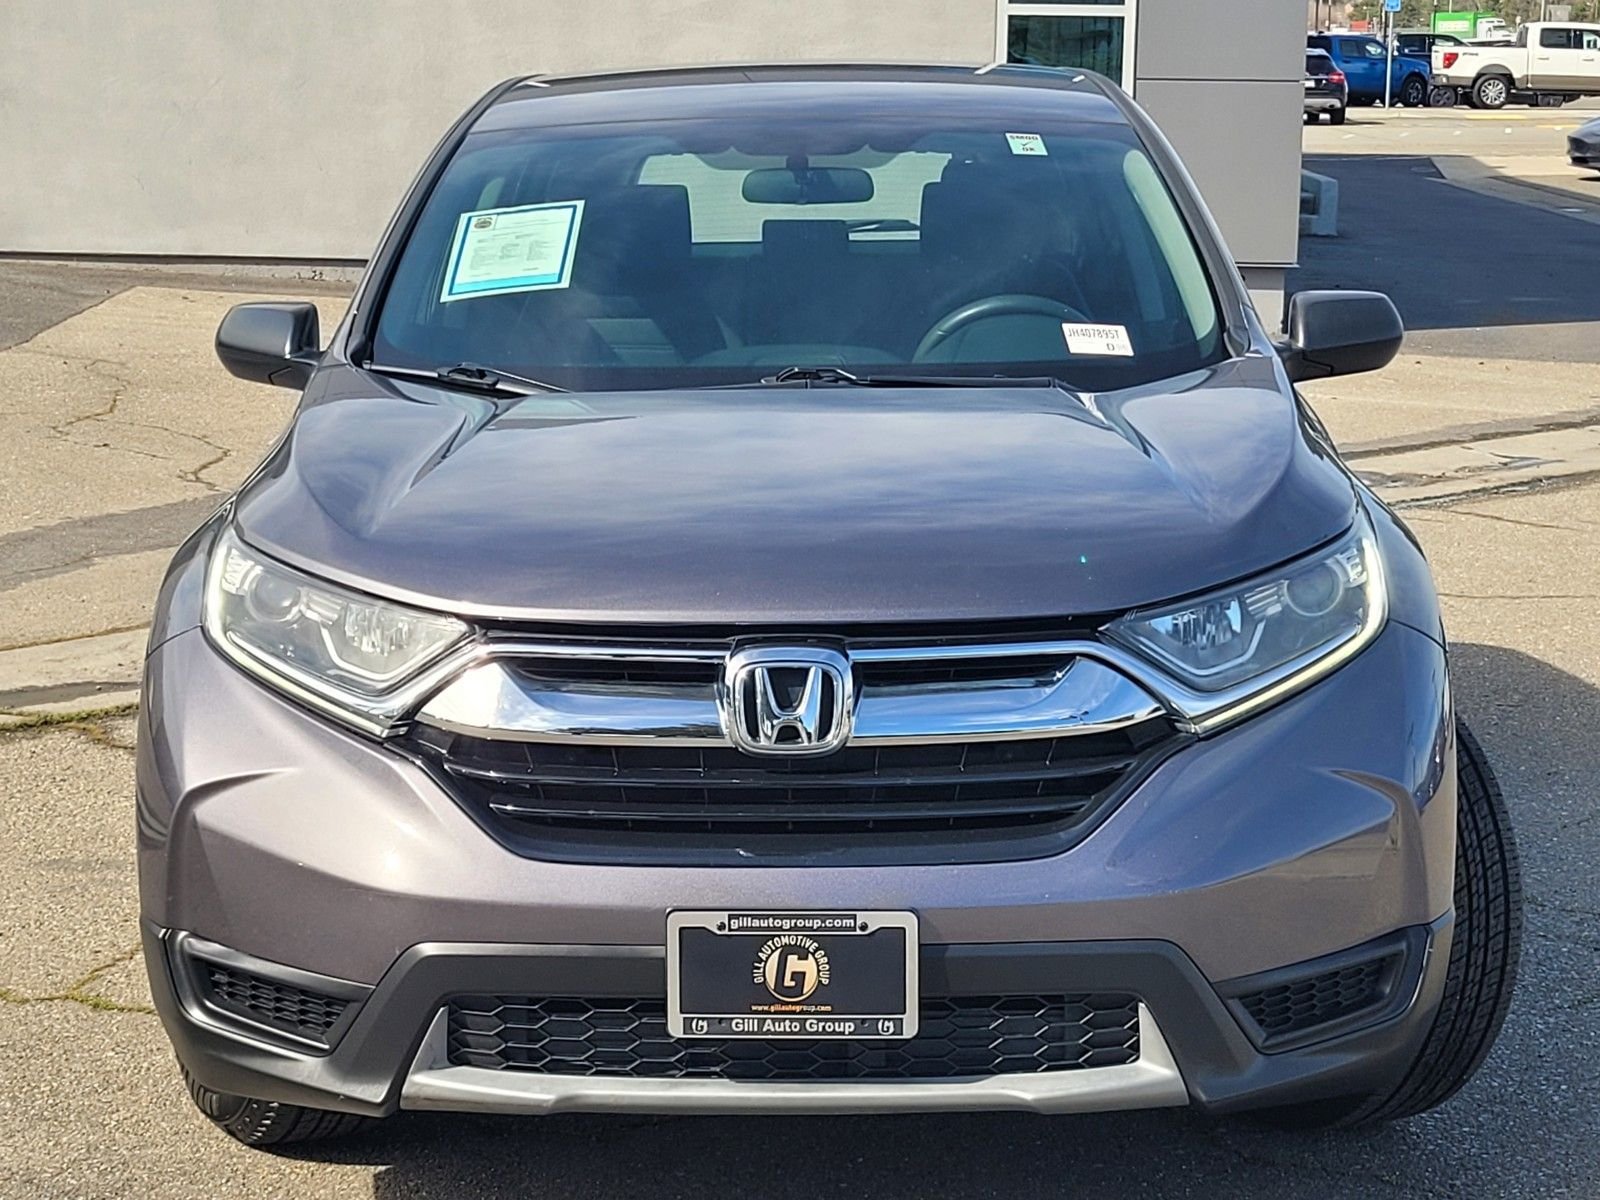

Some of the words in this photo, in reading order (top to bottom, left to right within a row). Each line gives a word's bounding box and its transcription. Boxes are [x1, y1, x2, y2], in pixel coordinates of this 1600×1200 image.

[730, 916, 855, 929] gillautogroup.com
[758, 935, 819, 961] AUTOMOTIVE
[752, 961, 765, 984] GILL
[814, 950, 831, 985] GROUP
[731, 1018, 758, 1032] Gill
[762, 1018, 801, 1032] Auto
[805, 1018, 855, 1035] Group
